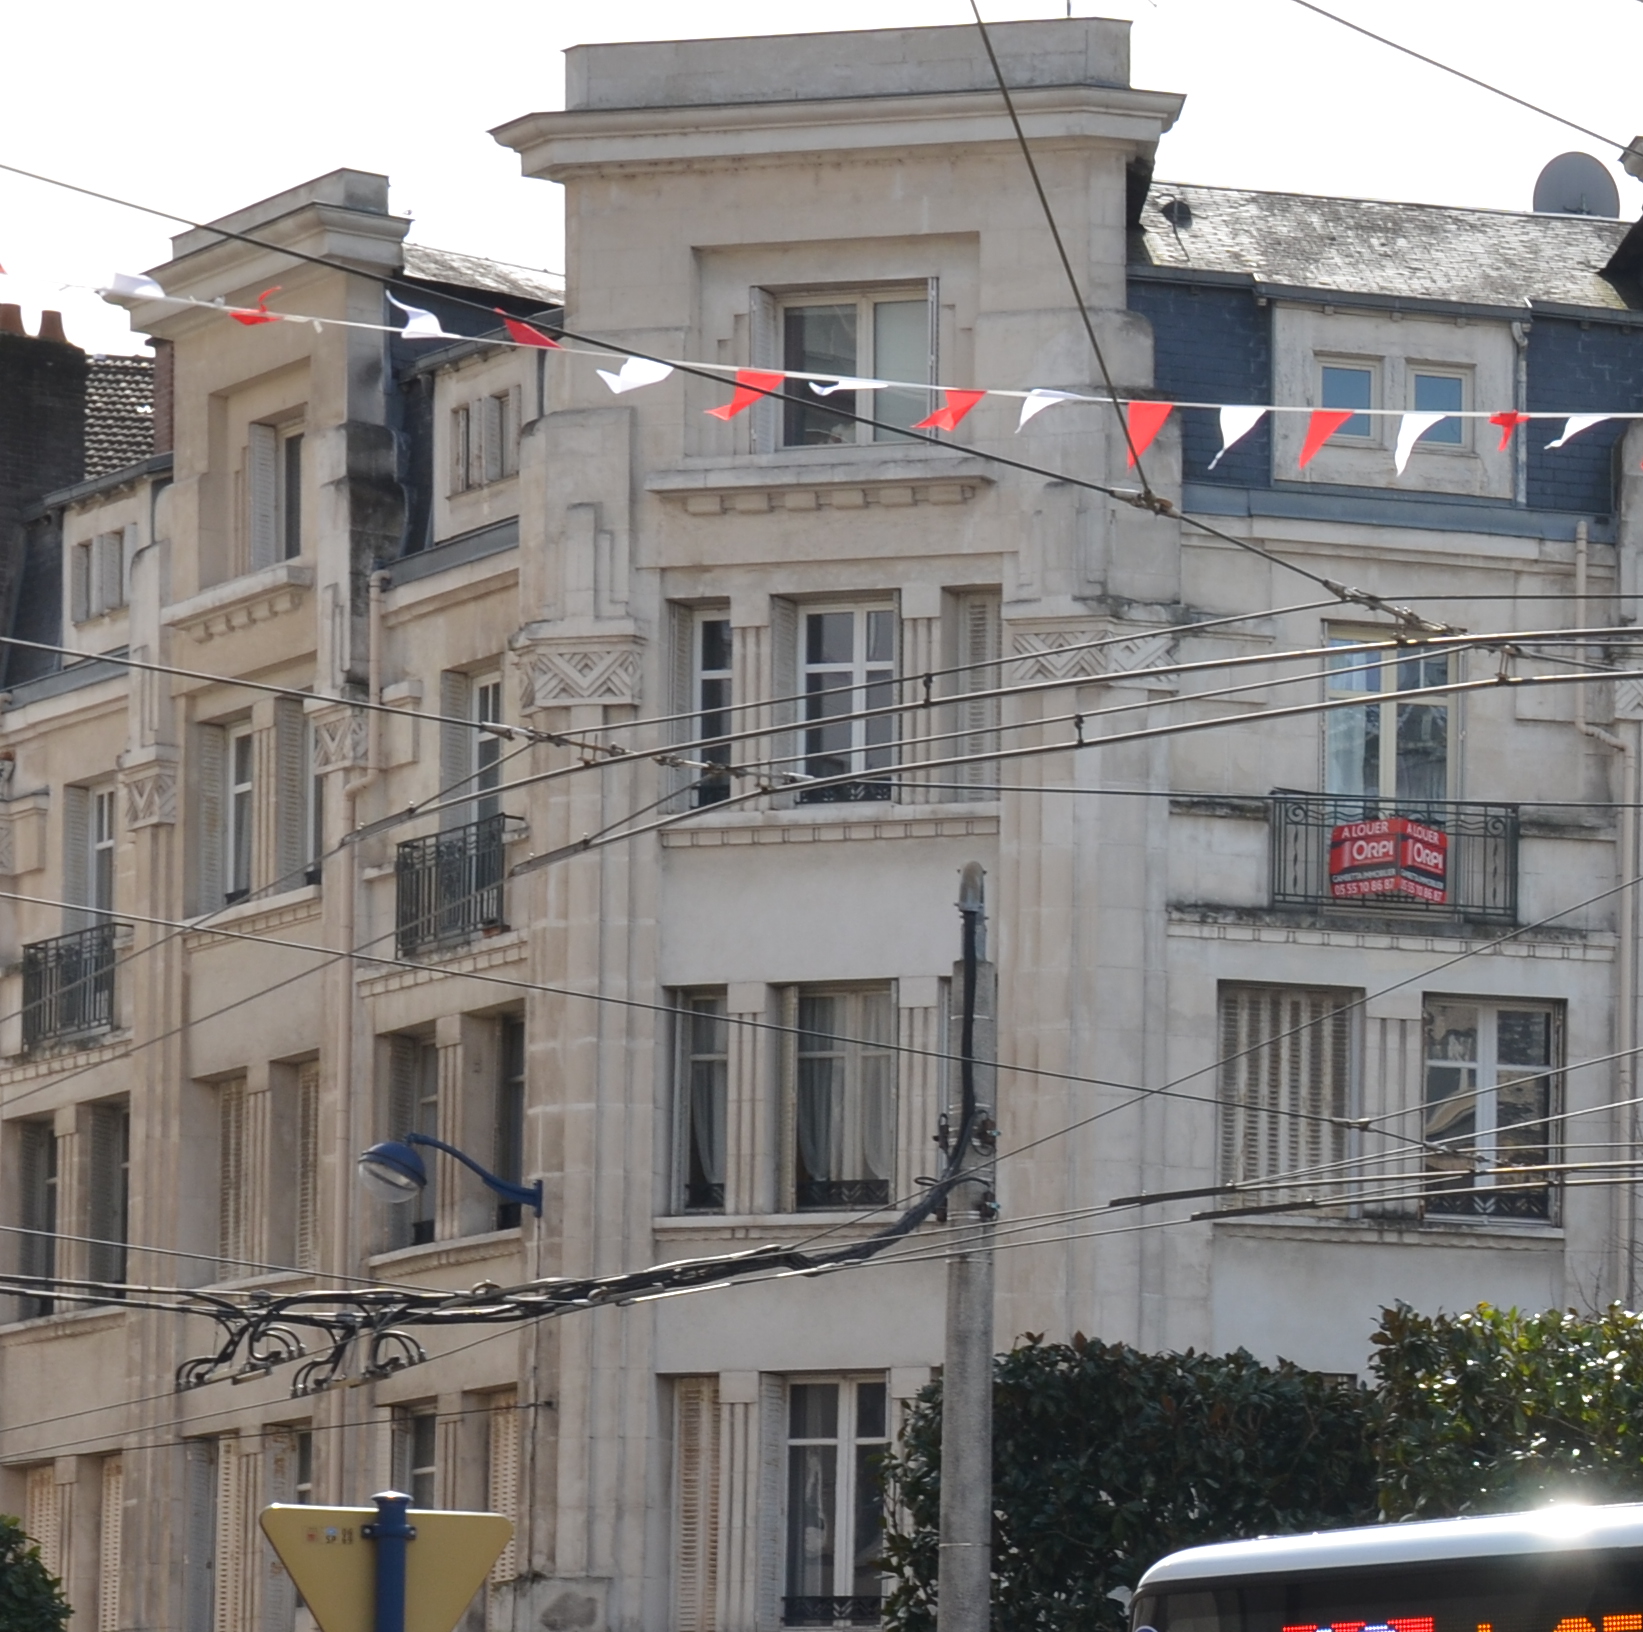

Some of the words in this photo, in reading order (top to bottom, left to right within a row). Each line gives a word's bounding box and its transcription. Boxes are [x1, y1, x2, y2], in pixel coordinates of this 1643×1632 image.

[1341, 827, 1351, 839] A
[1352, 821, 1389, 838] LOUER
[1413, 825, 1440, 844] LOUER
[1352, 840, 1394, 860] ORPI
[1413, 842, 1444, 870] ORPI
